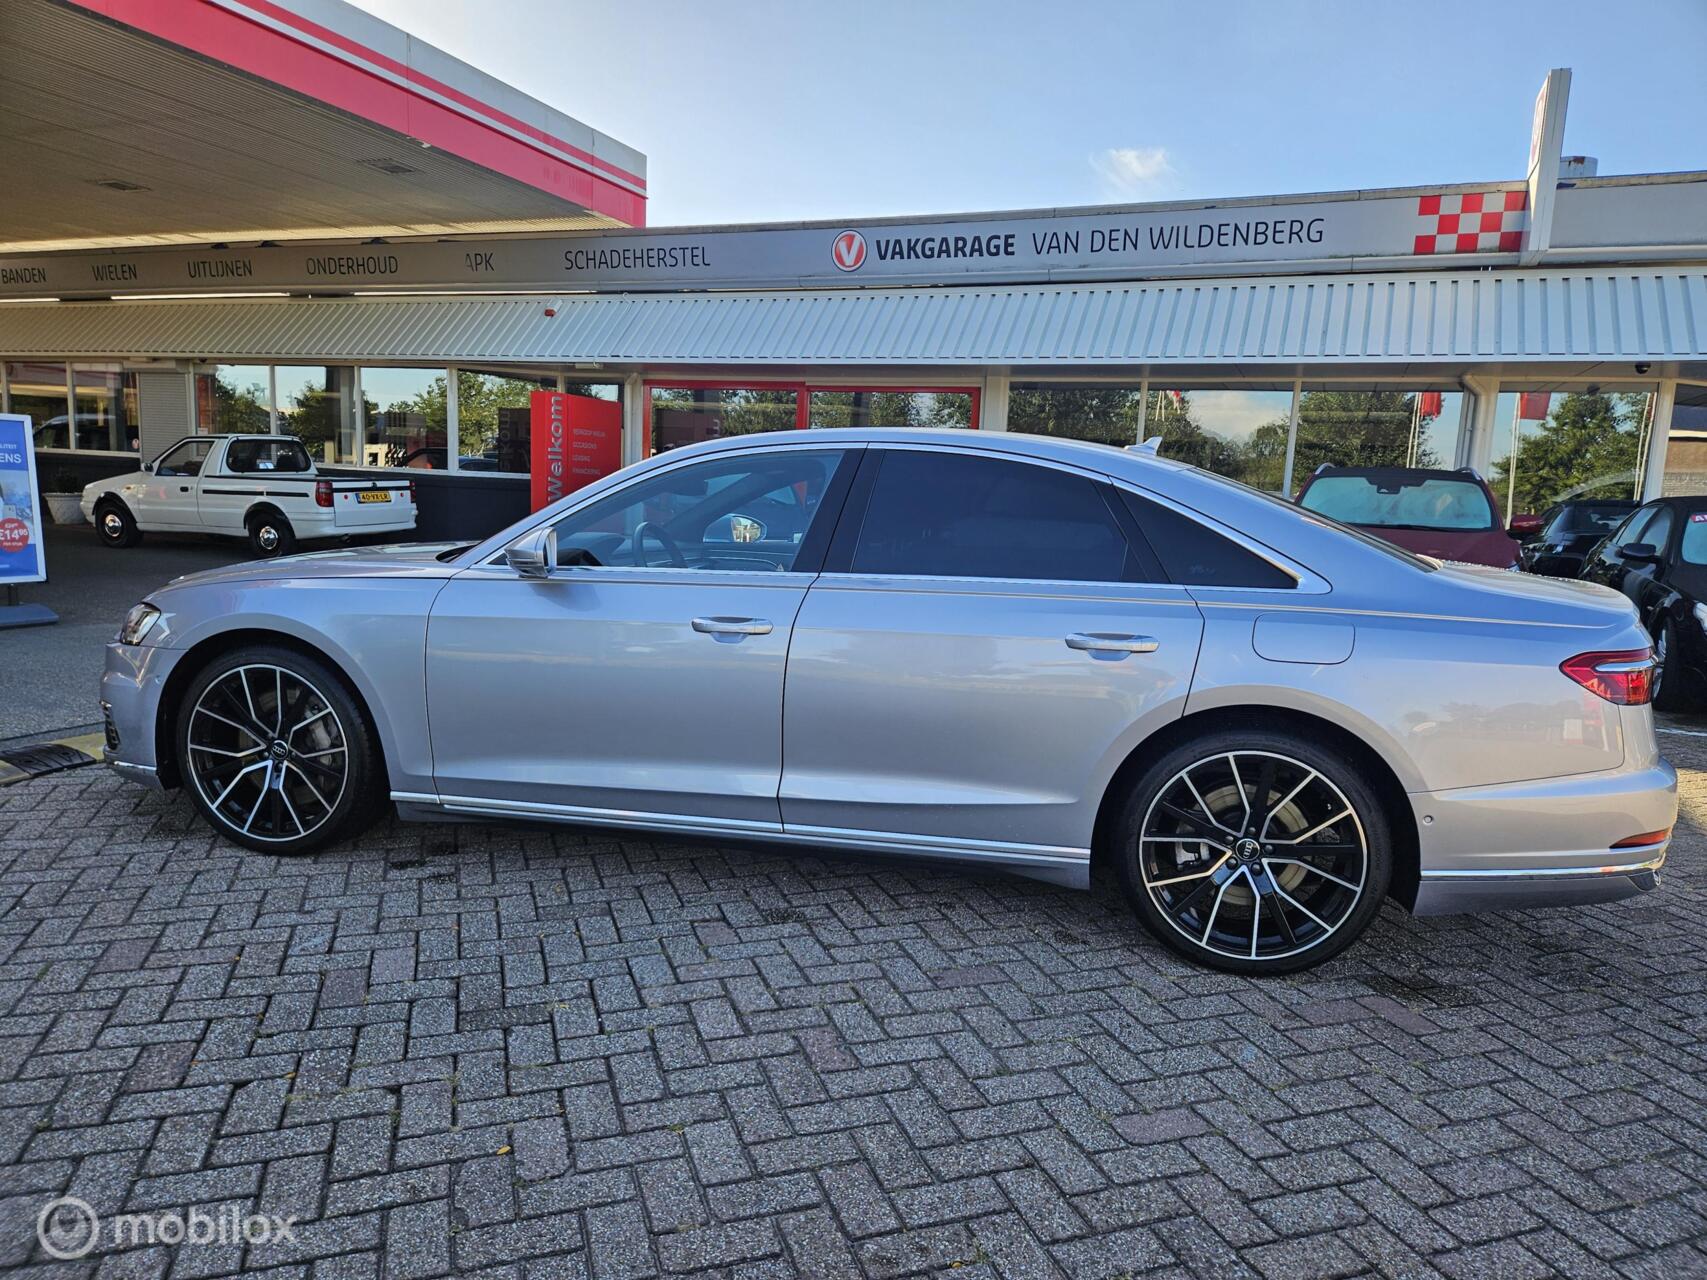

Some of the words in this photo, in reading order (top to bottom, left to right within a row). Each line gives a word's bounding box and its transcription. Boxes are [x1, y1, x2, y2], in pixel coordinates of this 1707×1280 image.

[876, 233, 1016, 261] VAKGARAGE
[1032, 229, 1079, 255] VAN
[1090, 227, 1139, 253] DEN
[1148, 217, 1325, 251] WILDENBERG
[187, 260, 253, 279] UITLIJNEN
[305, 255, 399, 276] ONDERHOUD
[465, 252, 495, 273] APK
[564, 246, 711, 272] SCHADEHERSTEL
[1, 267, 47, 285] BANDEN
[92, 264, 138, 282] WIELEN
[547, 396, 563, 503] Welkom
